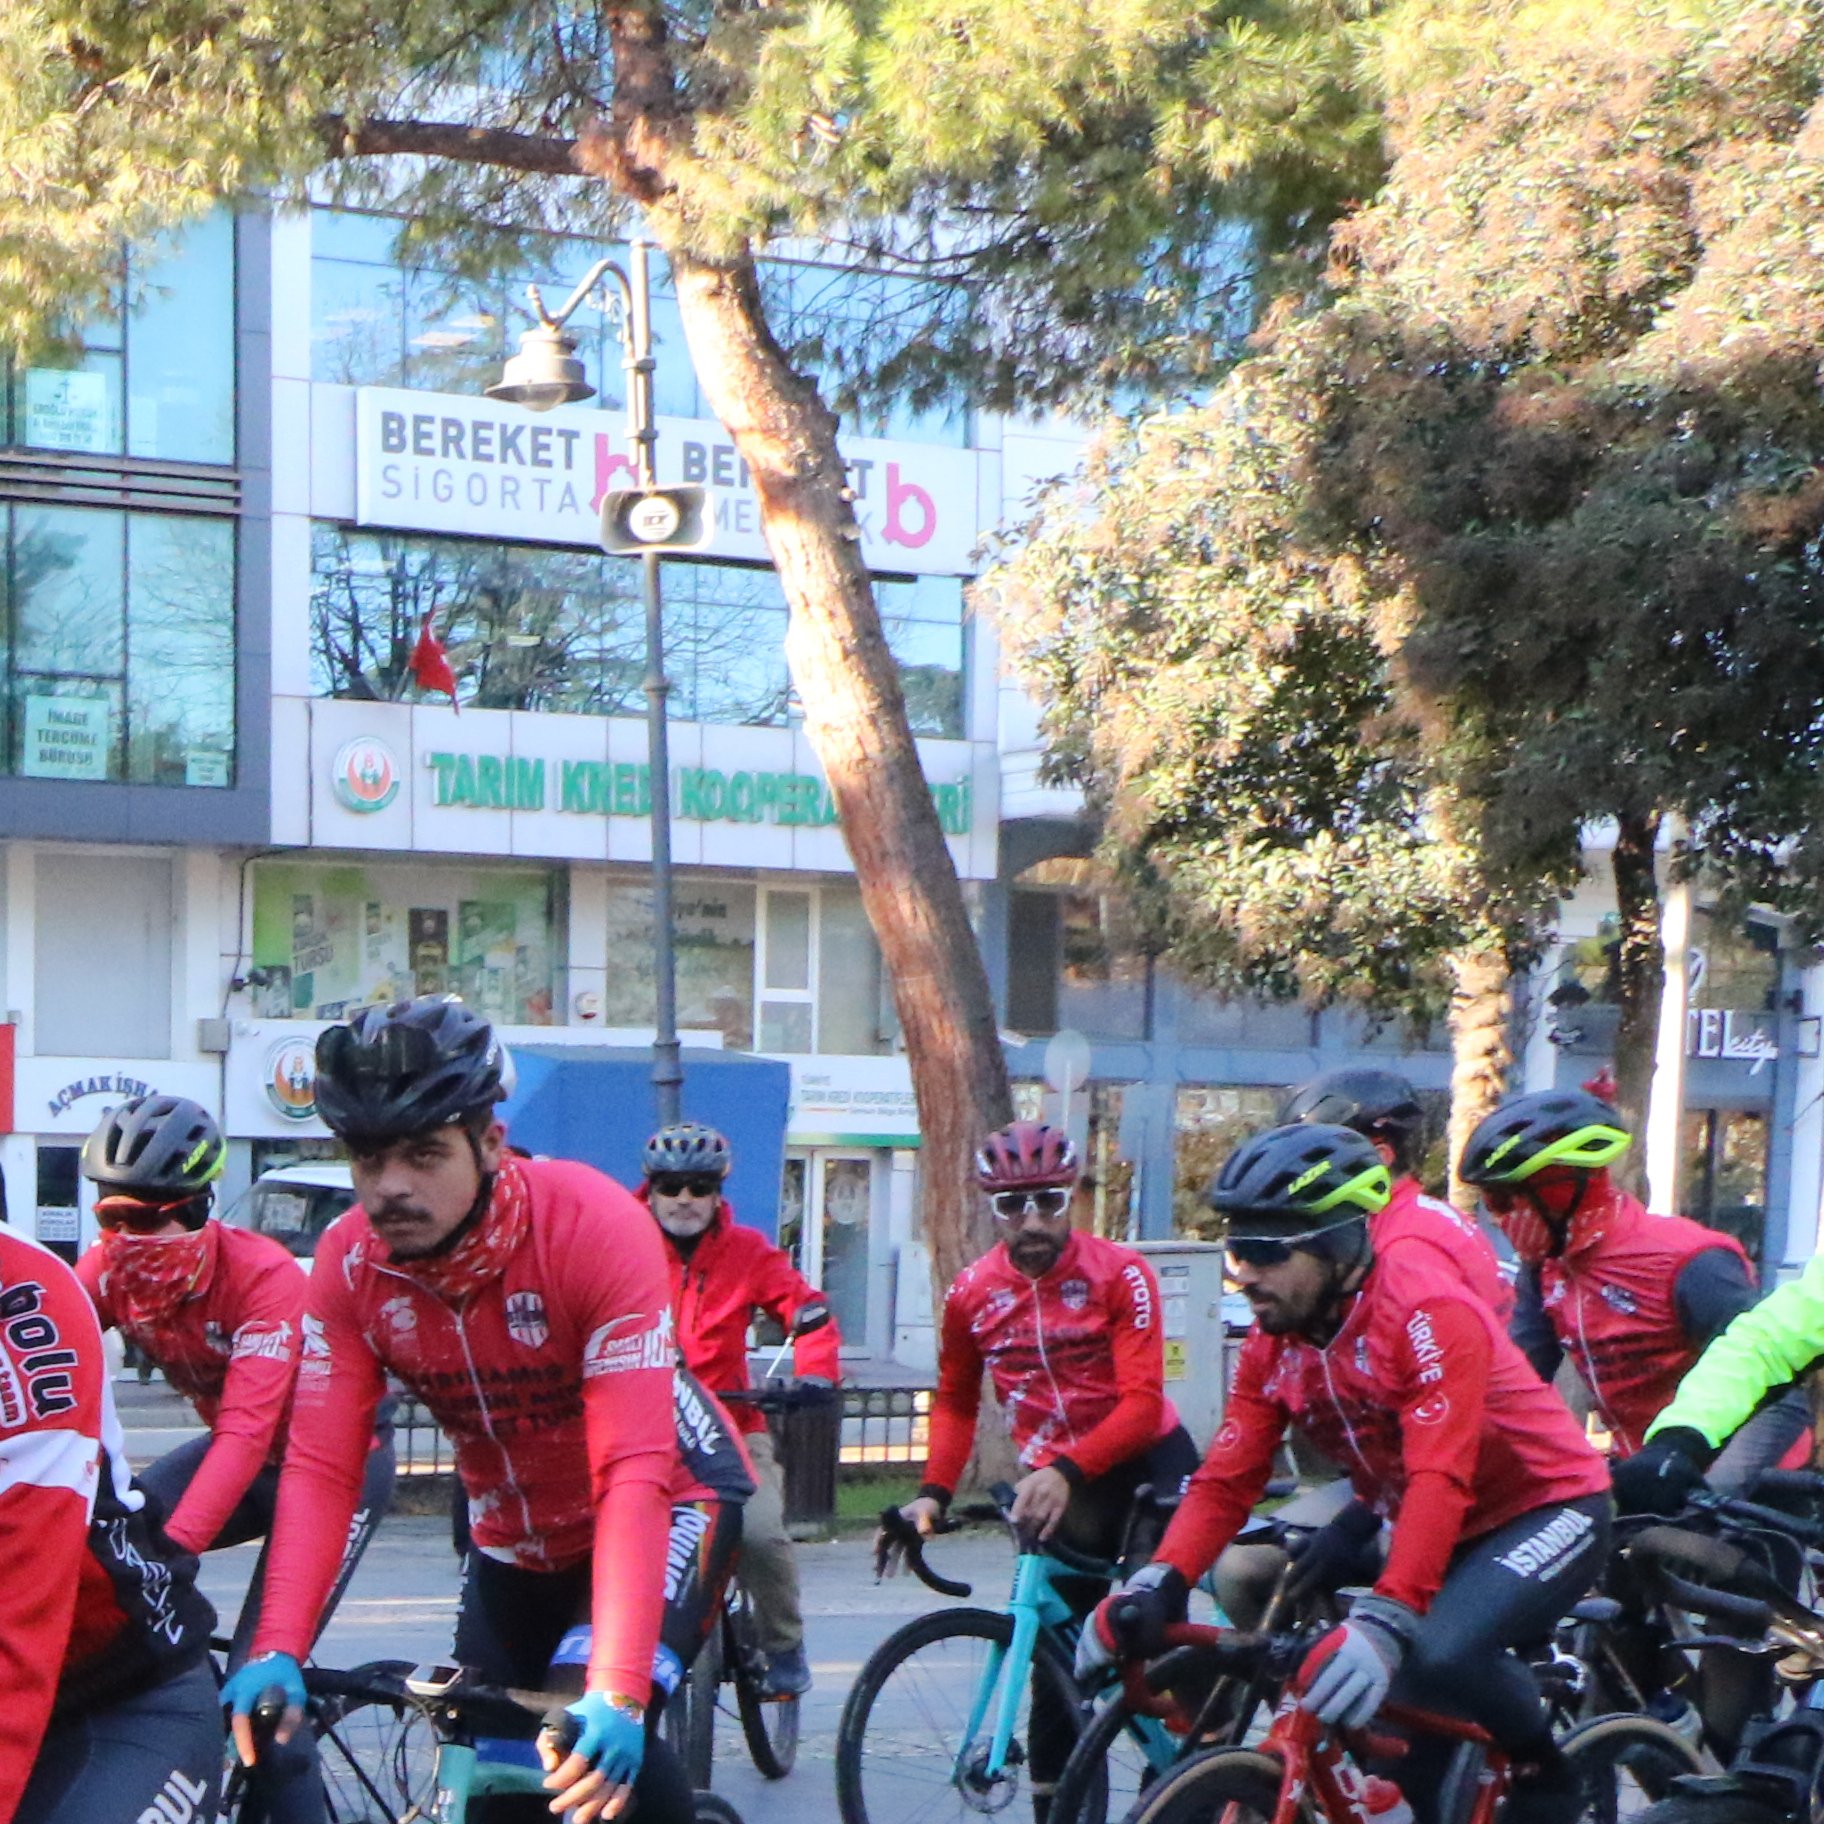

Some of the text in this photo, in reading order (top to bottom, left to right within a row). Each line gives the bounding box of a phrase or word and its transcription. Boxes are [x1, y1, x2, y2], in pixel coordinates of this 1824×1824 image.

[381, 411, 581, 471] BEREKET
[426, 752, 546, 811] TARIM
[48, 1075, 112, 1117] AÇMAK
[1494, 1508, 1594, 1578] İSTANBUL
